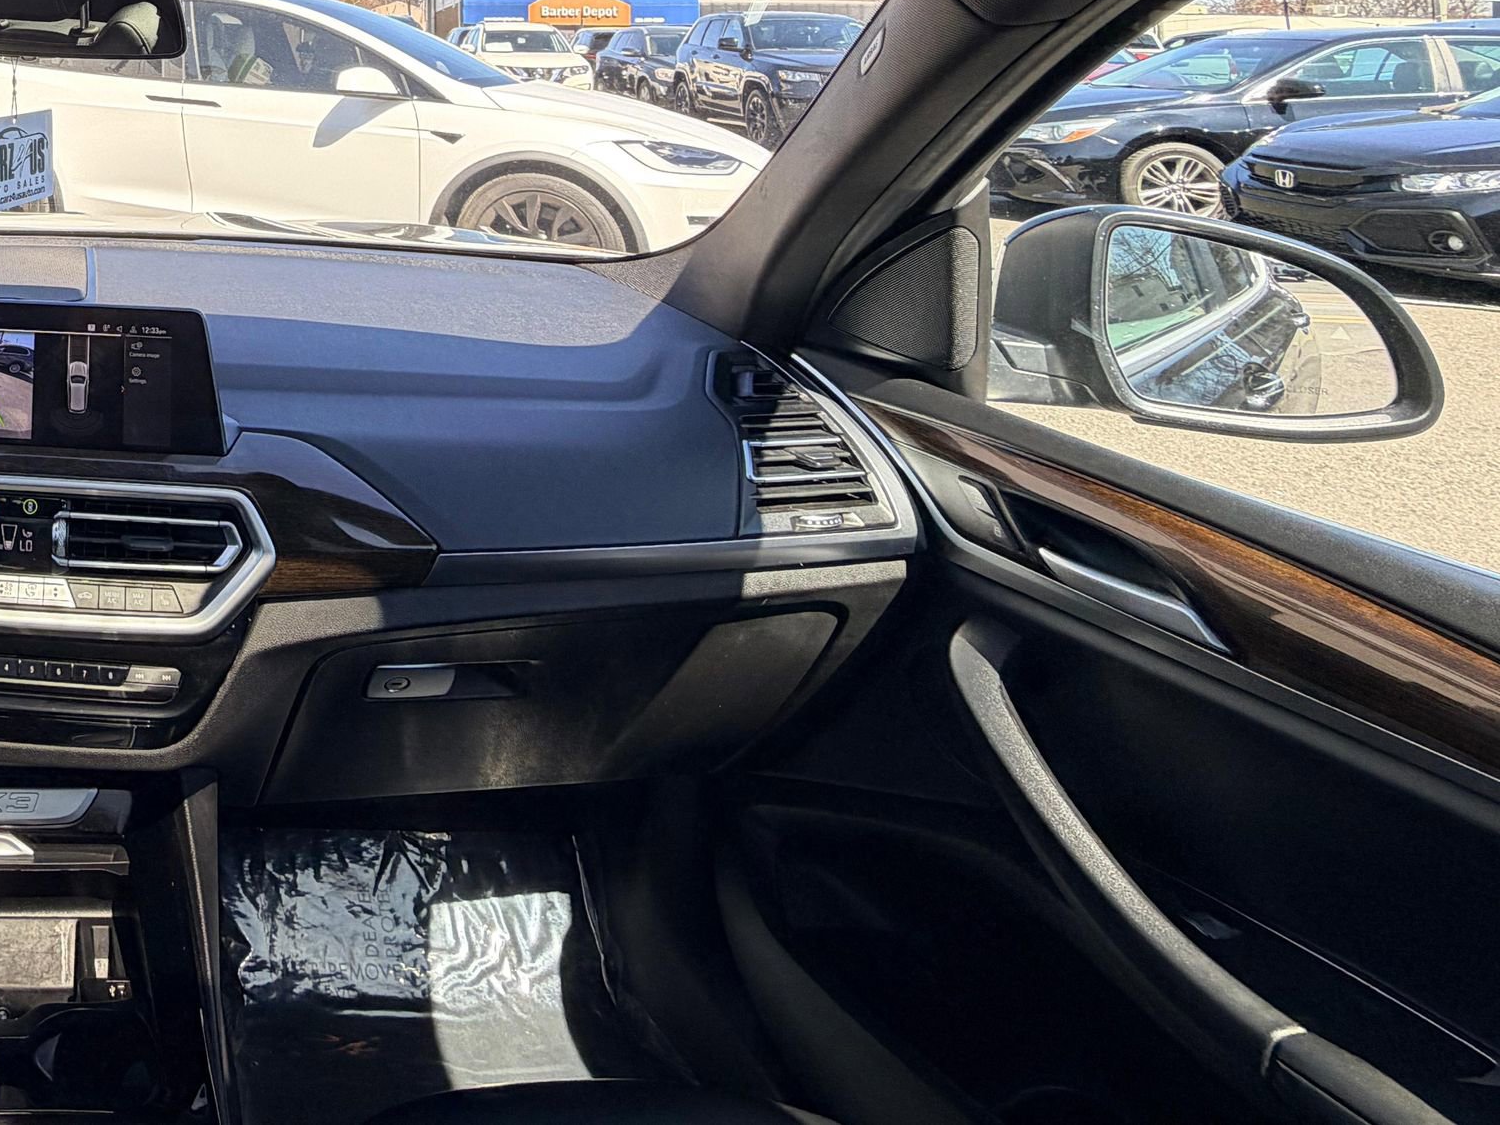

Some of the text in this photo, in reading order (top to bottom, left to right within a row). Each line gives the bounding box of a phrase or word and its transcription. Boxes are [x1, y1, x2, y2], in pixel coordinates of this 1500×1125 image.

[540, 6, 618, 20] Barber Depot
[30, 137, 46, 176] US
[16, 175, 45, 190] SALES
